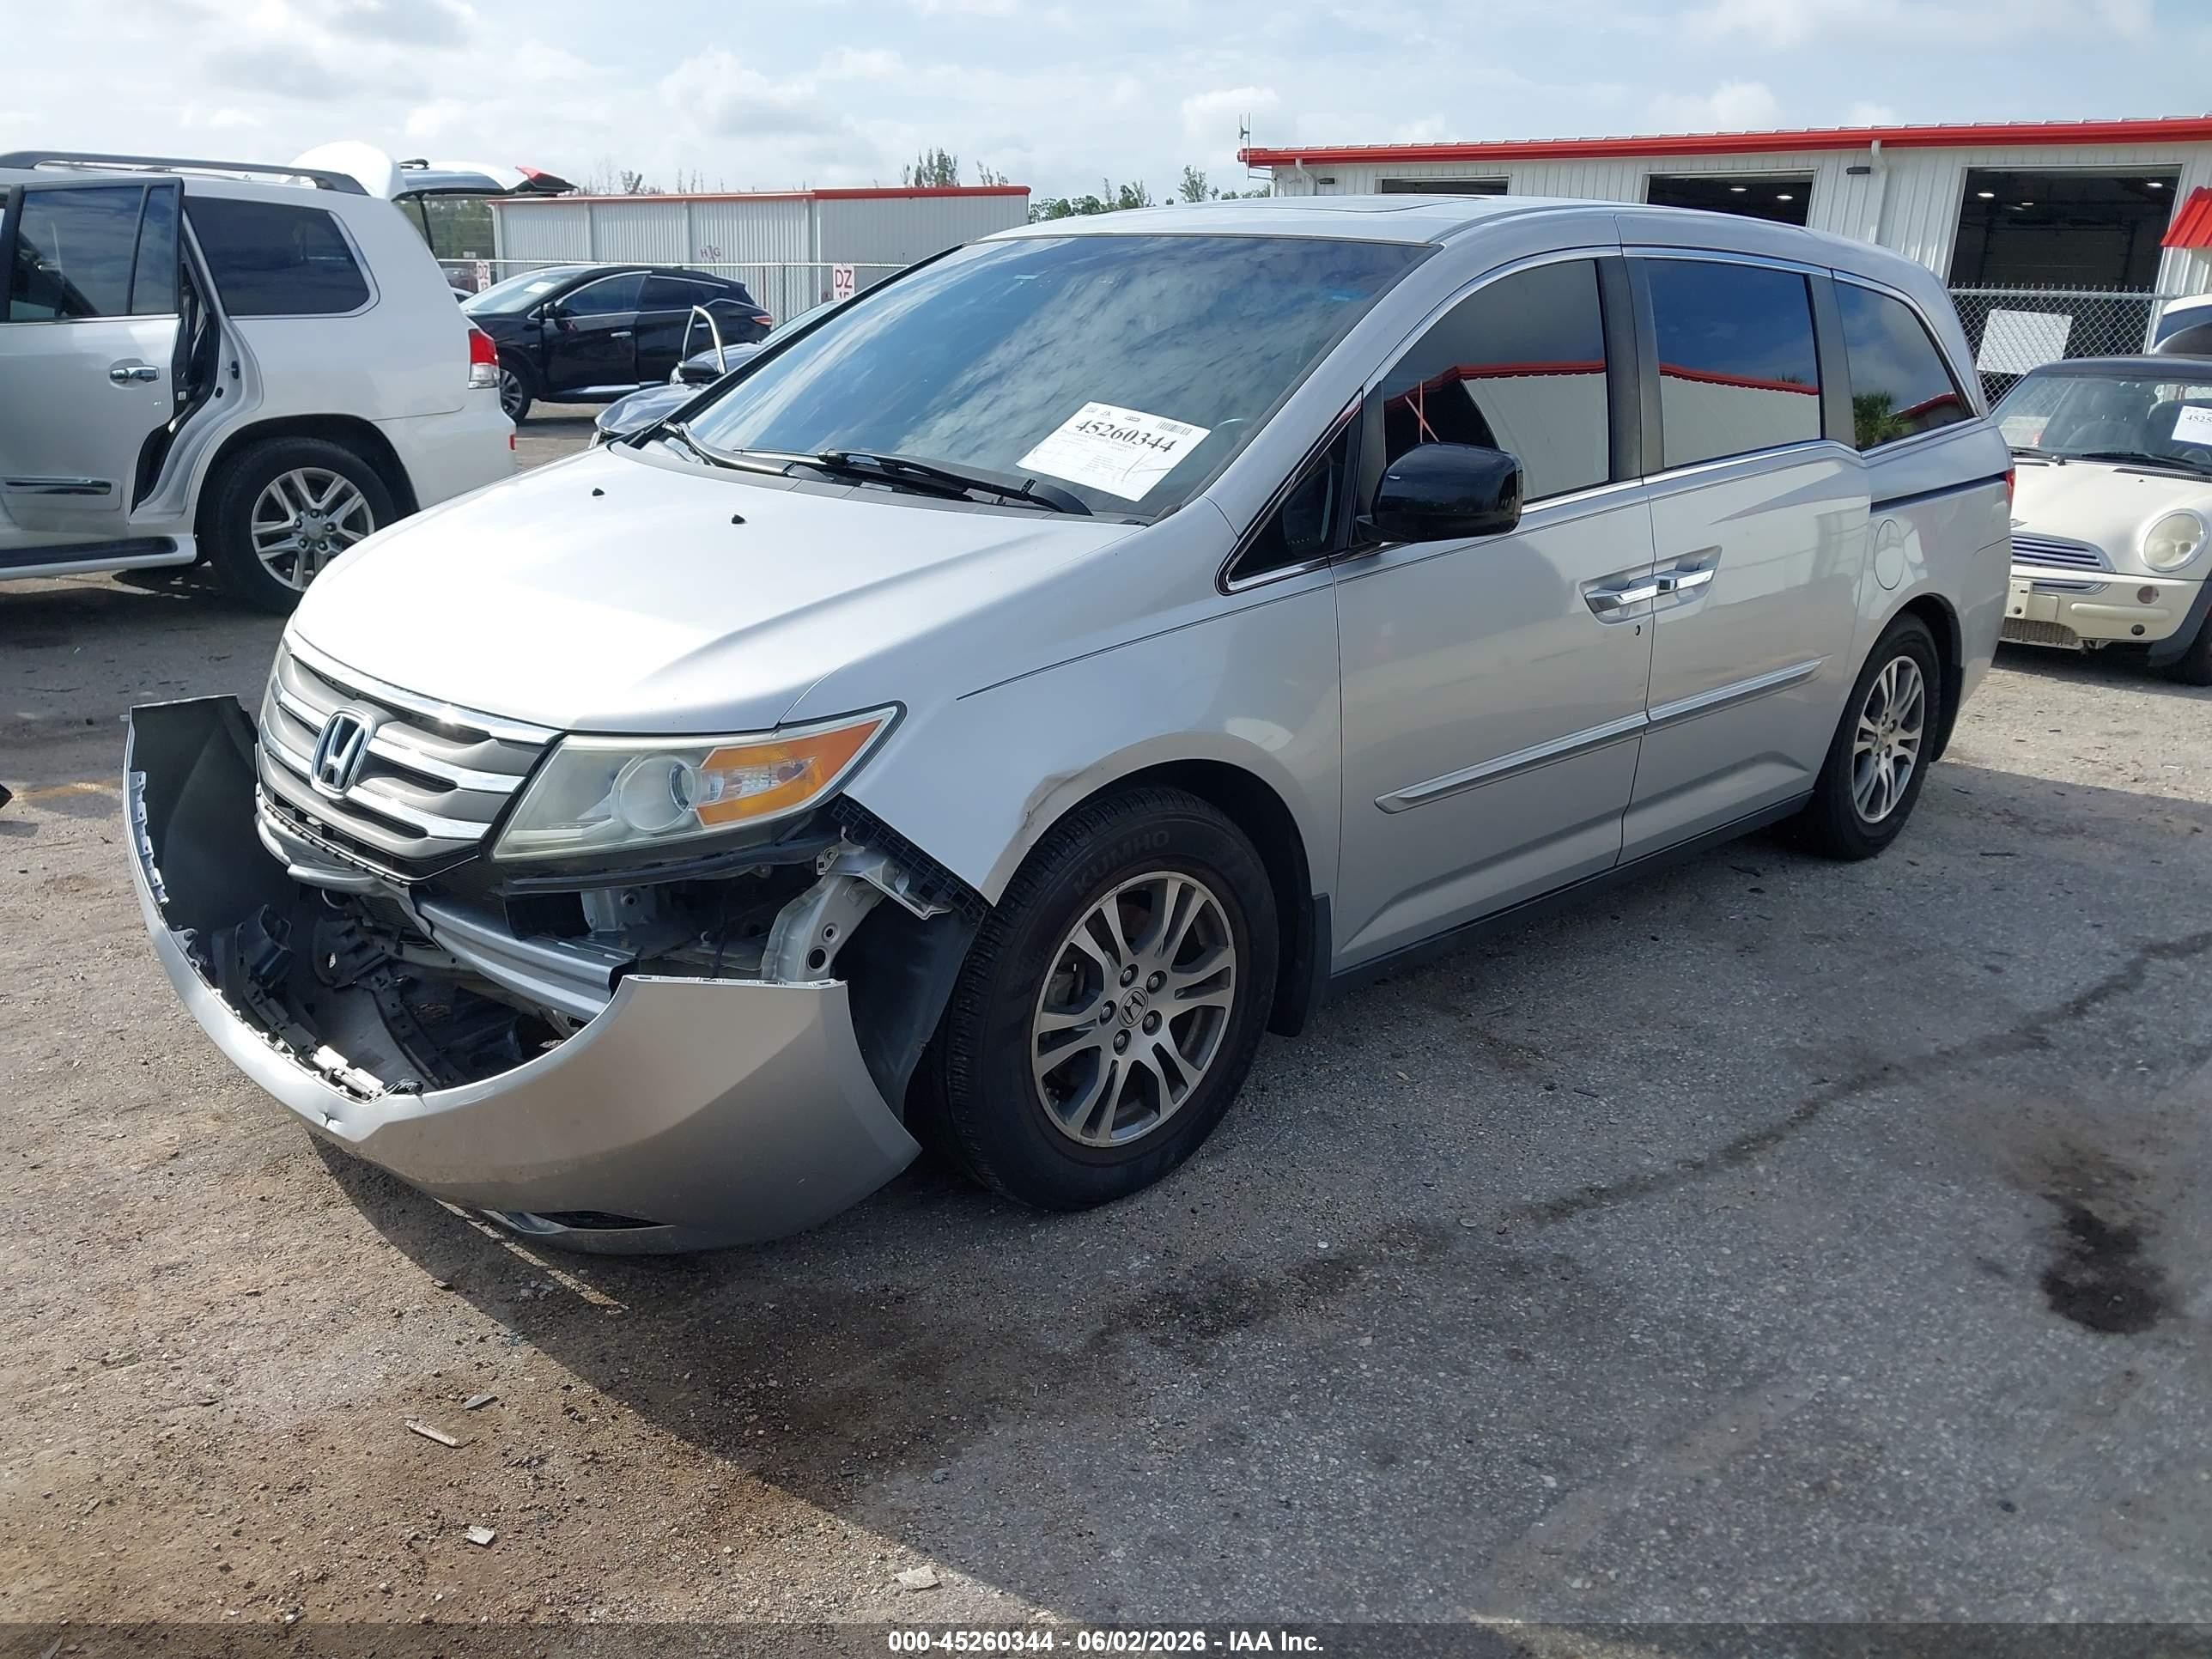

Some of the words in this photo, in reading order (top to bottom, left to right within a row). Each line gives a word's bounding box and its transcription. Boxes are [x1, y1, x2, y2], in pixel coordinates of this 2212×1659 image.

[835, 269, 853, 289] DZ
[1075, 419, 1177, 453] 45260344
[1074, 830, 1170, 894] KUMHO
